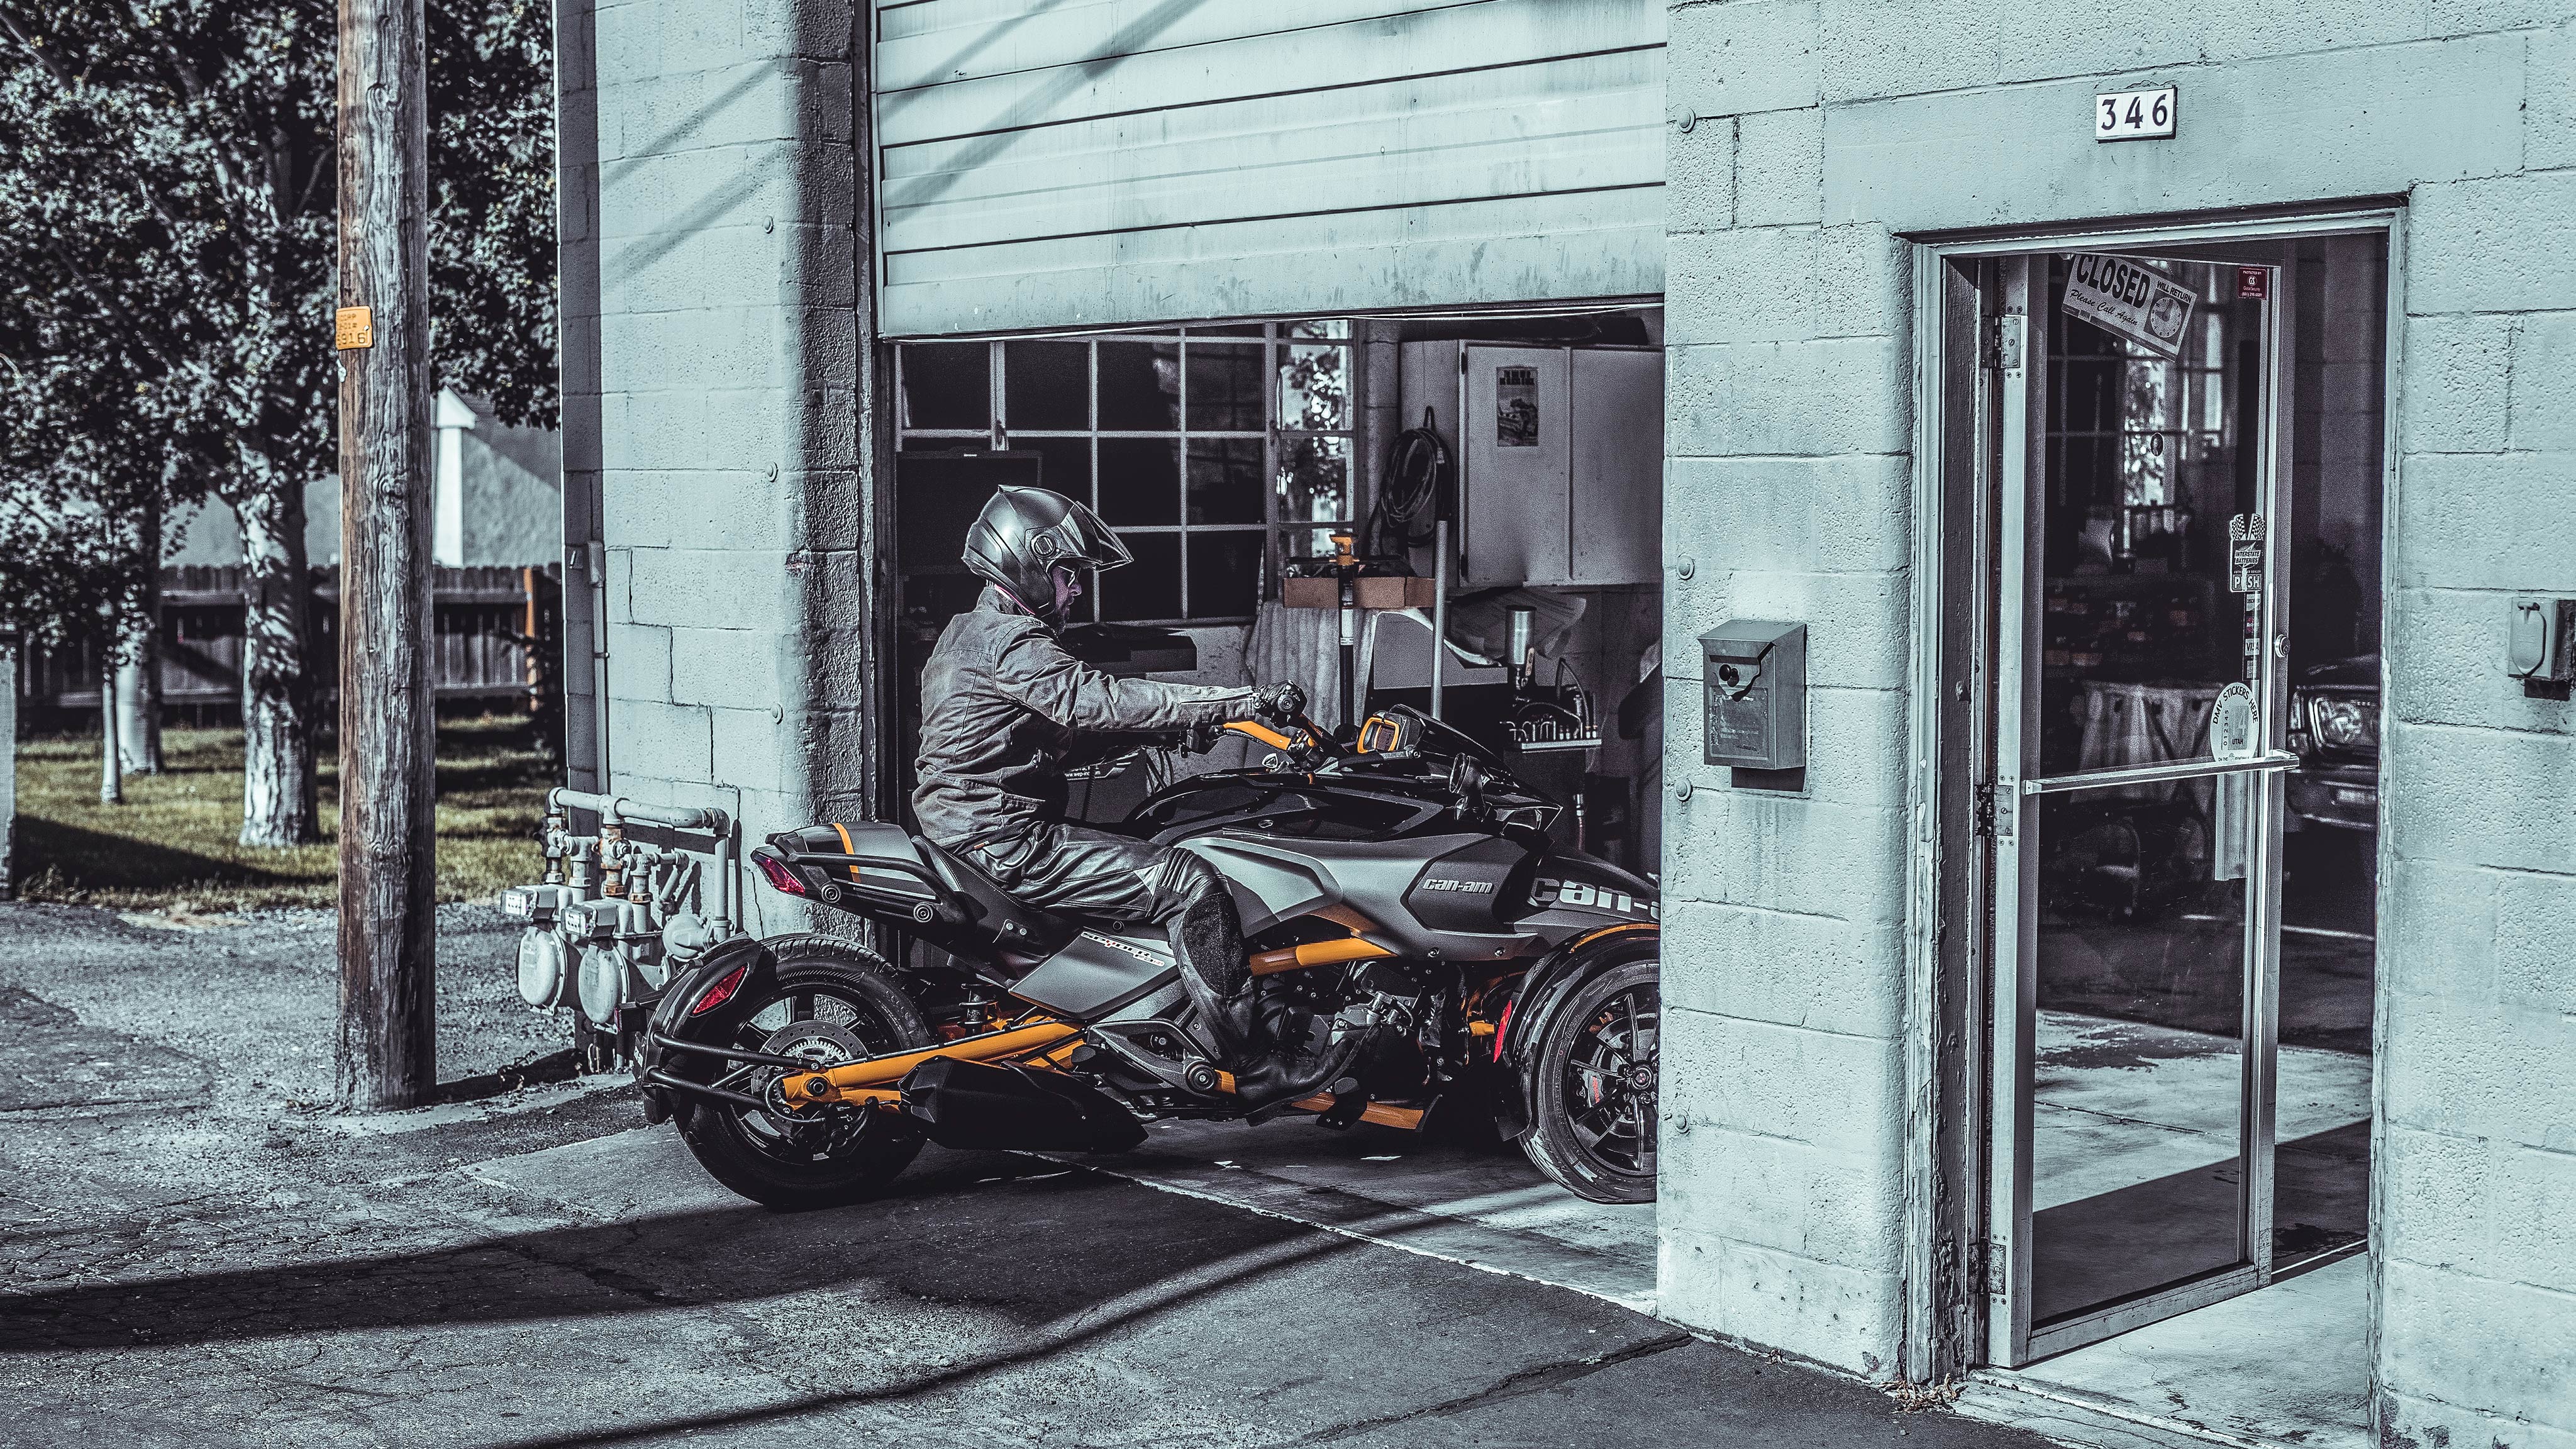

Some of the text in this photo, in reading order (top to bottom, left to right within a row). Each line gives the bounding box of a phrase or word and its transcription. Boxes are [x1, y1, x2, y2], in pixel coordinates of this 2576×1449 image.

[2101, 94, 2168, 131] 346
[2077, 255, 2150, 308] CLOSED
[2157, 280, 2192, 303] WILL RETURN
[2070, 289, 2138, 326] Please Call Again
[2235, 576, 2260, 589] PSH
[2213, 686, 2258, 724] DMV STICKERS HERE
[1423, 878, 1494, 894] can-am
[1082, 932, 1151, 957] SPYDER
